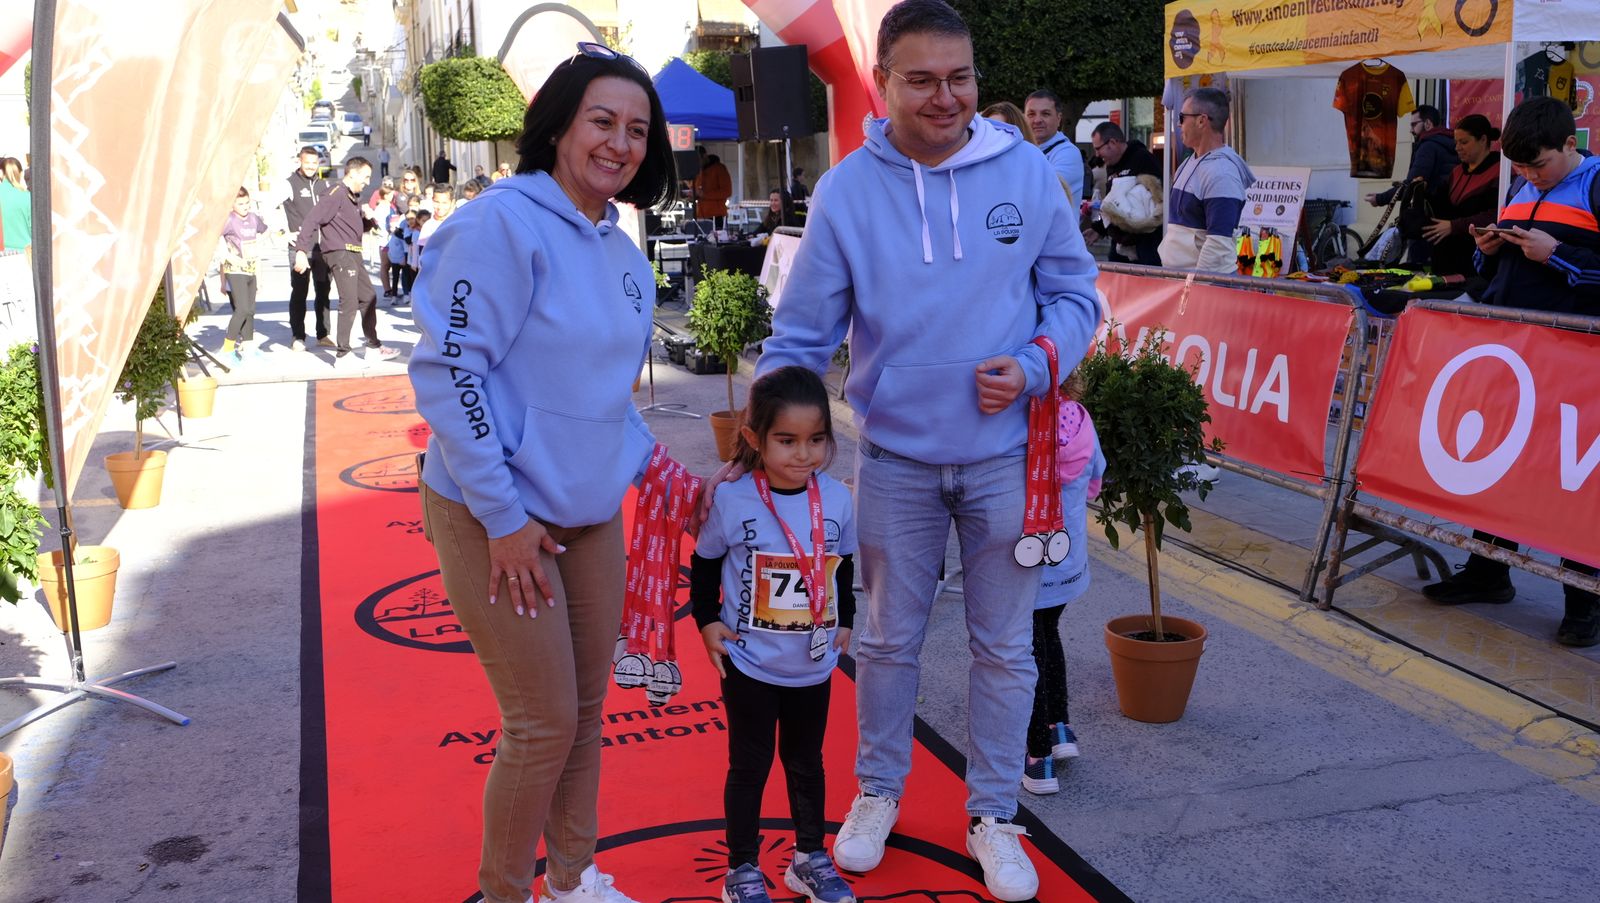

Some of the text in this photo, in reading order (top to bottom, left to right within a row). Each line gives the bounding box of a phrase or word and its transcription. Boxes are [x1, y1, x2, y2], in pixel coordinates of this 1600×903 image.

[1250, 180, 1302, 191] ALCETINES
[1246, 193, 1299, 204] SOLIDARIOS
[386, 520, 422, 528] Ay
[771, 572, 809, 598] 74
[438, 729, 502, 747] Ay
[600, 717, 727, 747] antori
